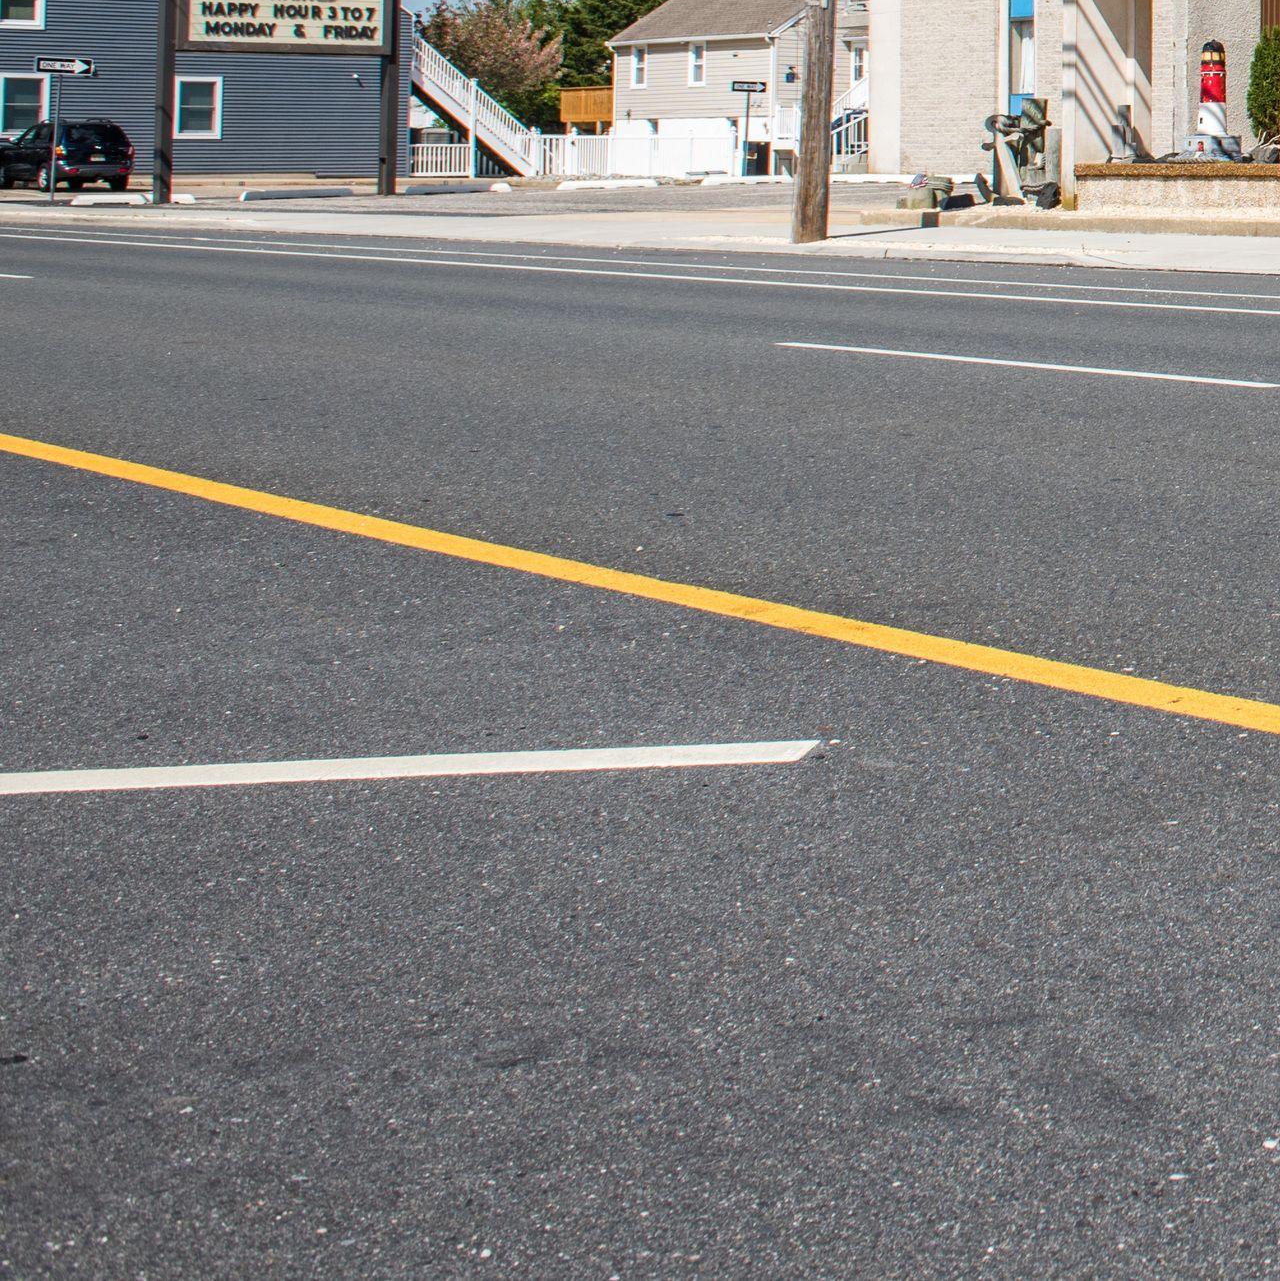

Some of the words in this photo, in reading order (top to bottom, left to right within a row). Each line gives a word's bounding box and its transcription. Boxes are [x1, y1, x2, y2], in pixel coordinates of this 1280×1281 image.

[201, 1, 260, 18] HAPPY
[273, 3, 322, 19] HOUR
[327, 6, 338, 19] 3
[341, 7, 364, 21] TO
[366, 7, 376, 22] 7
[204, 20, 277, 37] MONDAY
[294, 23, 307, 39] &
[323, 25, 378, 40] FRIDAY
[41, 61, 57, 69] ONE
